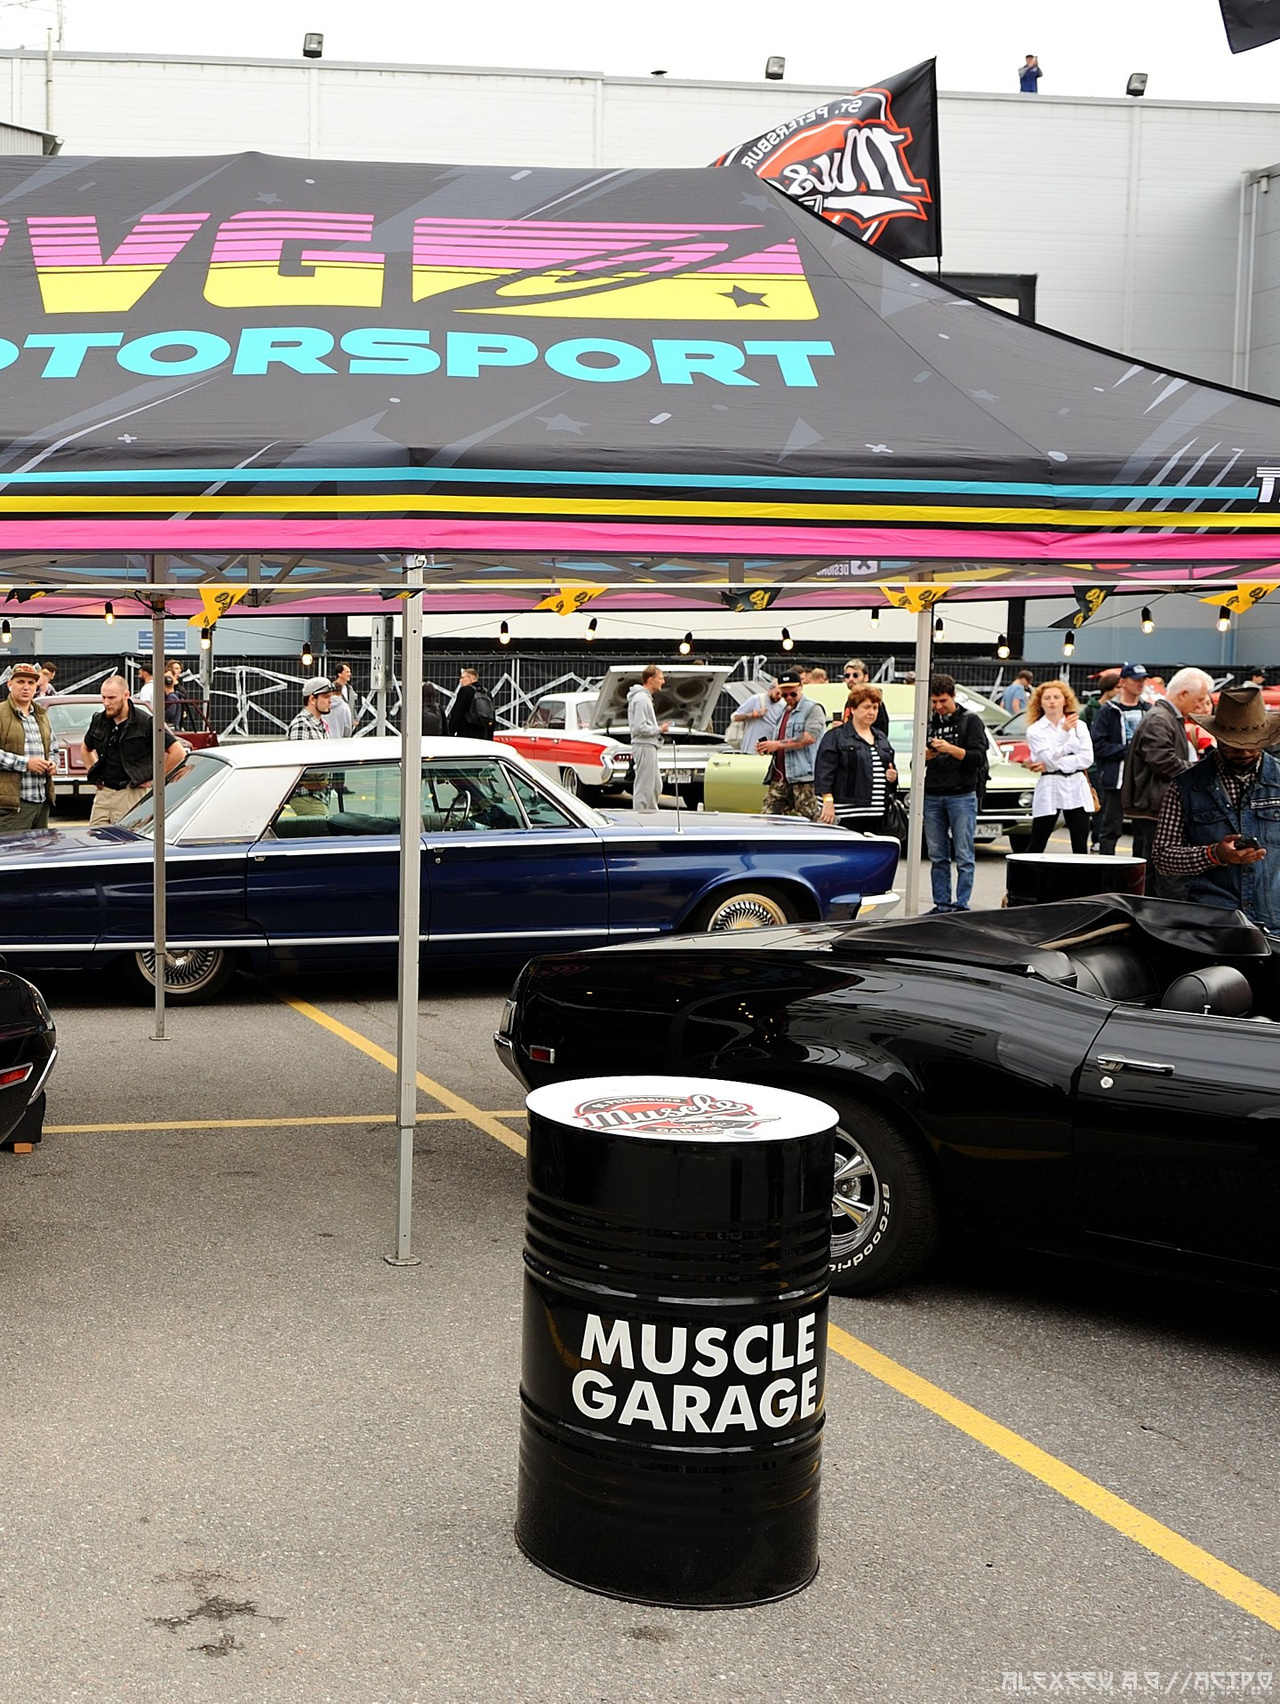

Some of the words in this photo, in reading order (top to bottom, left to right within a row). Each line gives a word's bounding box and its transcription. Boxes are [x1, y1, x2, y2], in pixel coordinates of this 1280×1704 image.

[582, 1094, 747, 1128] Muscle
[829, 1183, 891, 1273] BFGoodric
[580, 1312, 816, 1378] MUSCLE
[571, 1366, 818, 1433] GARAGE
